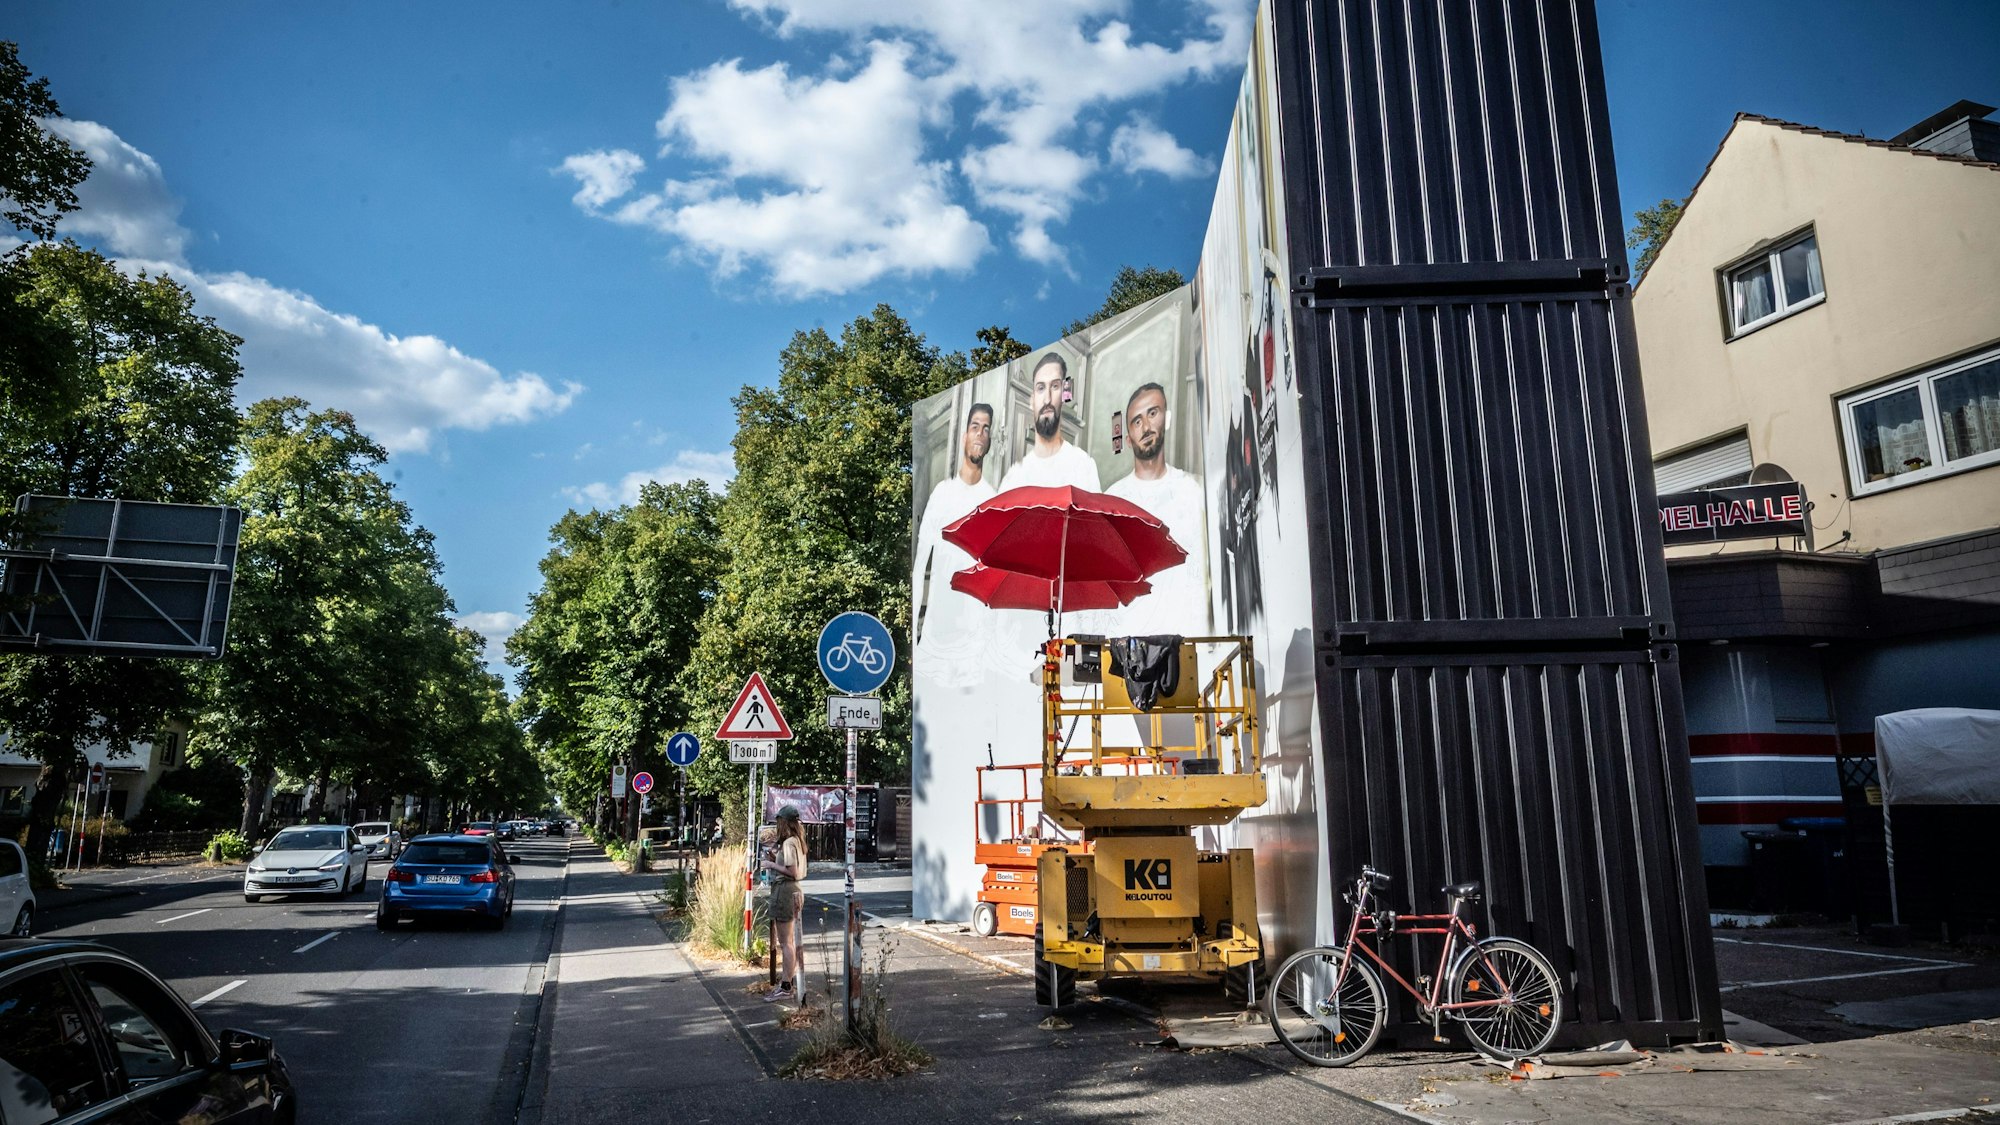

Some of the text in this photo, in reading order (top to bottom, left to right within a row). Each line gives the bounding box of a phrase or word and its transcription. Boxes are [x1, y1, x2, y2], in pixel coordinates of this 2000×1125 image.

[839, 706, 871, 719] Ende
[740, 747, 767, 758] 300 m
[1011, 908, 1034, 918] Boels
